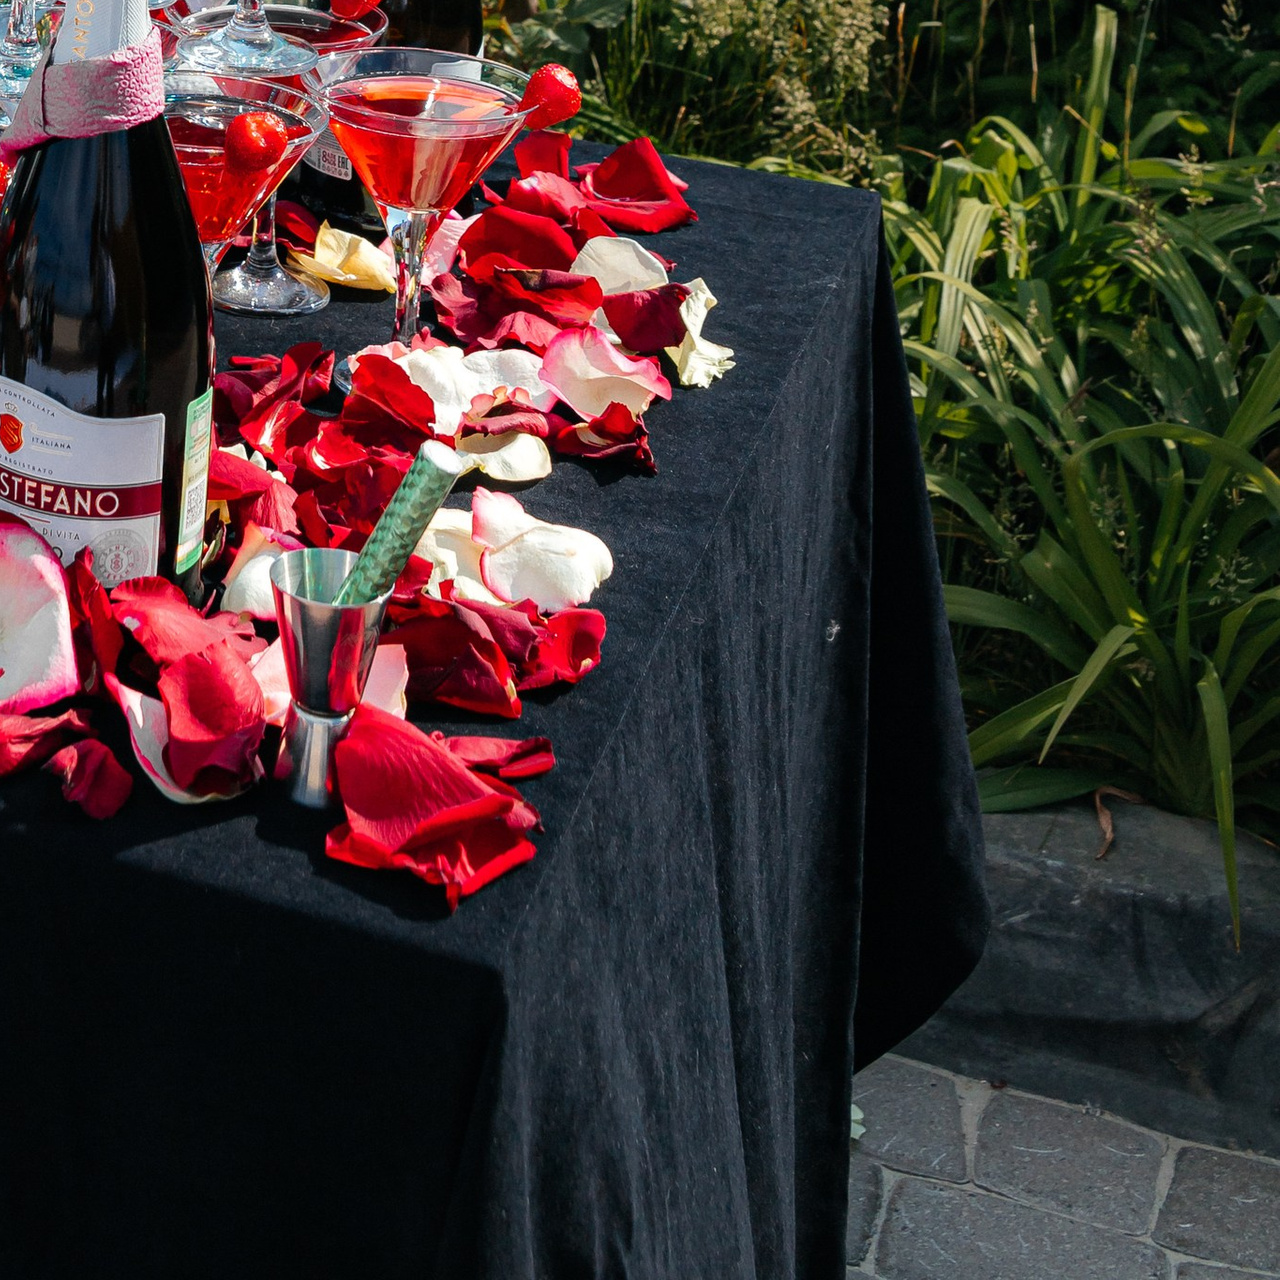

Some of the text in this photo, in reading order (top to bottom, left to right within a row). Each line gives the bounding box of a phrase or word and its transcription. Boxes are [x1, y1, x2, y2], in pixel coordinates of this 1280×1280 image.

[3, 388, 56, 418] CONTROLLATA
[31, 436, 72, 450] ITALIANA
[4, 455, 54, 476] REGISTRATO
[0, 472, 120, 516] STEFANO
[42, 527, 53, 537] DI
[56, 530, 80, 541] VITA
